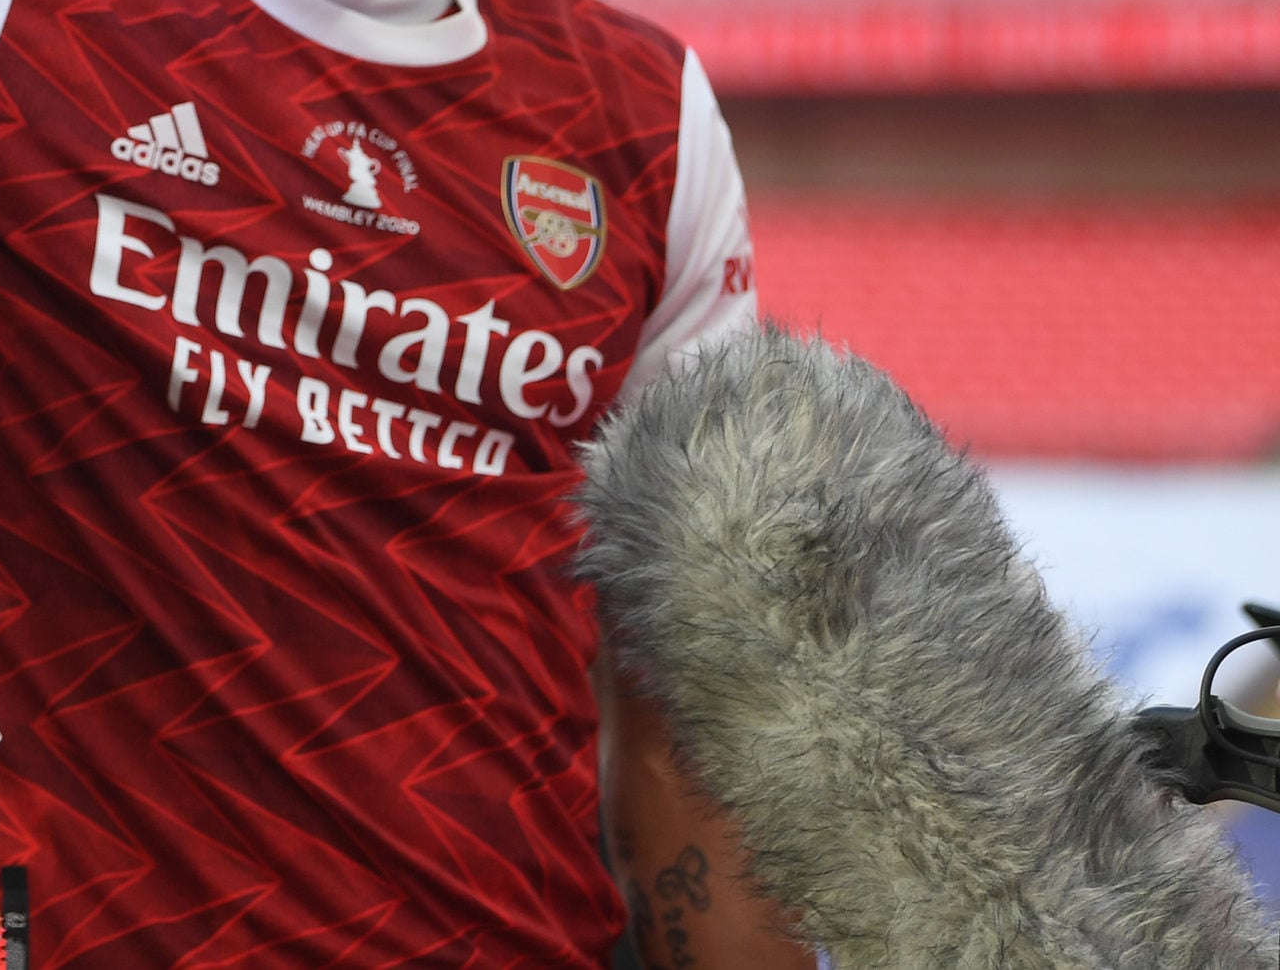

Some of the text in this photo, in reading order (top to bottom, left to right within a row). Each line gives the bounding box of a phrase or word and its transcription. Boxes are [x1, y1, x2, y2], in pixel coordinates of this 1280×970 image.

[111, 137, 221, 186] adidas
[302, 195, 420, 236] WEMBLEY 2020
[90, 193, 604, 428] Emirates
[167, 335, 272, 429] FLY
